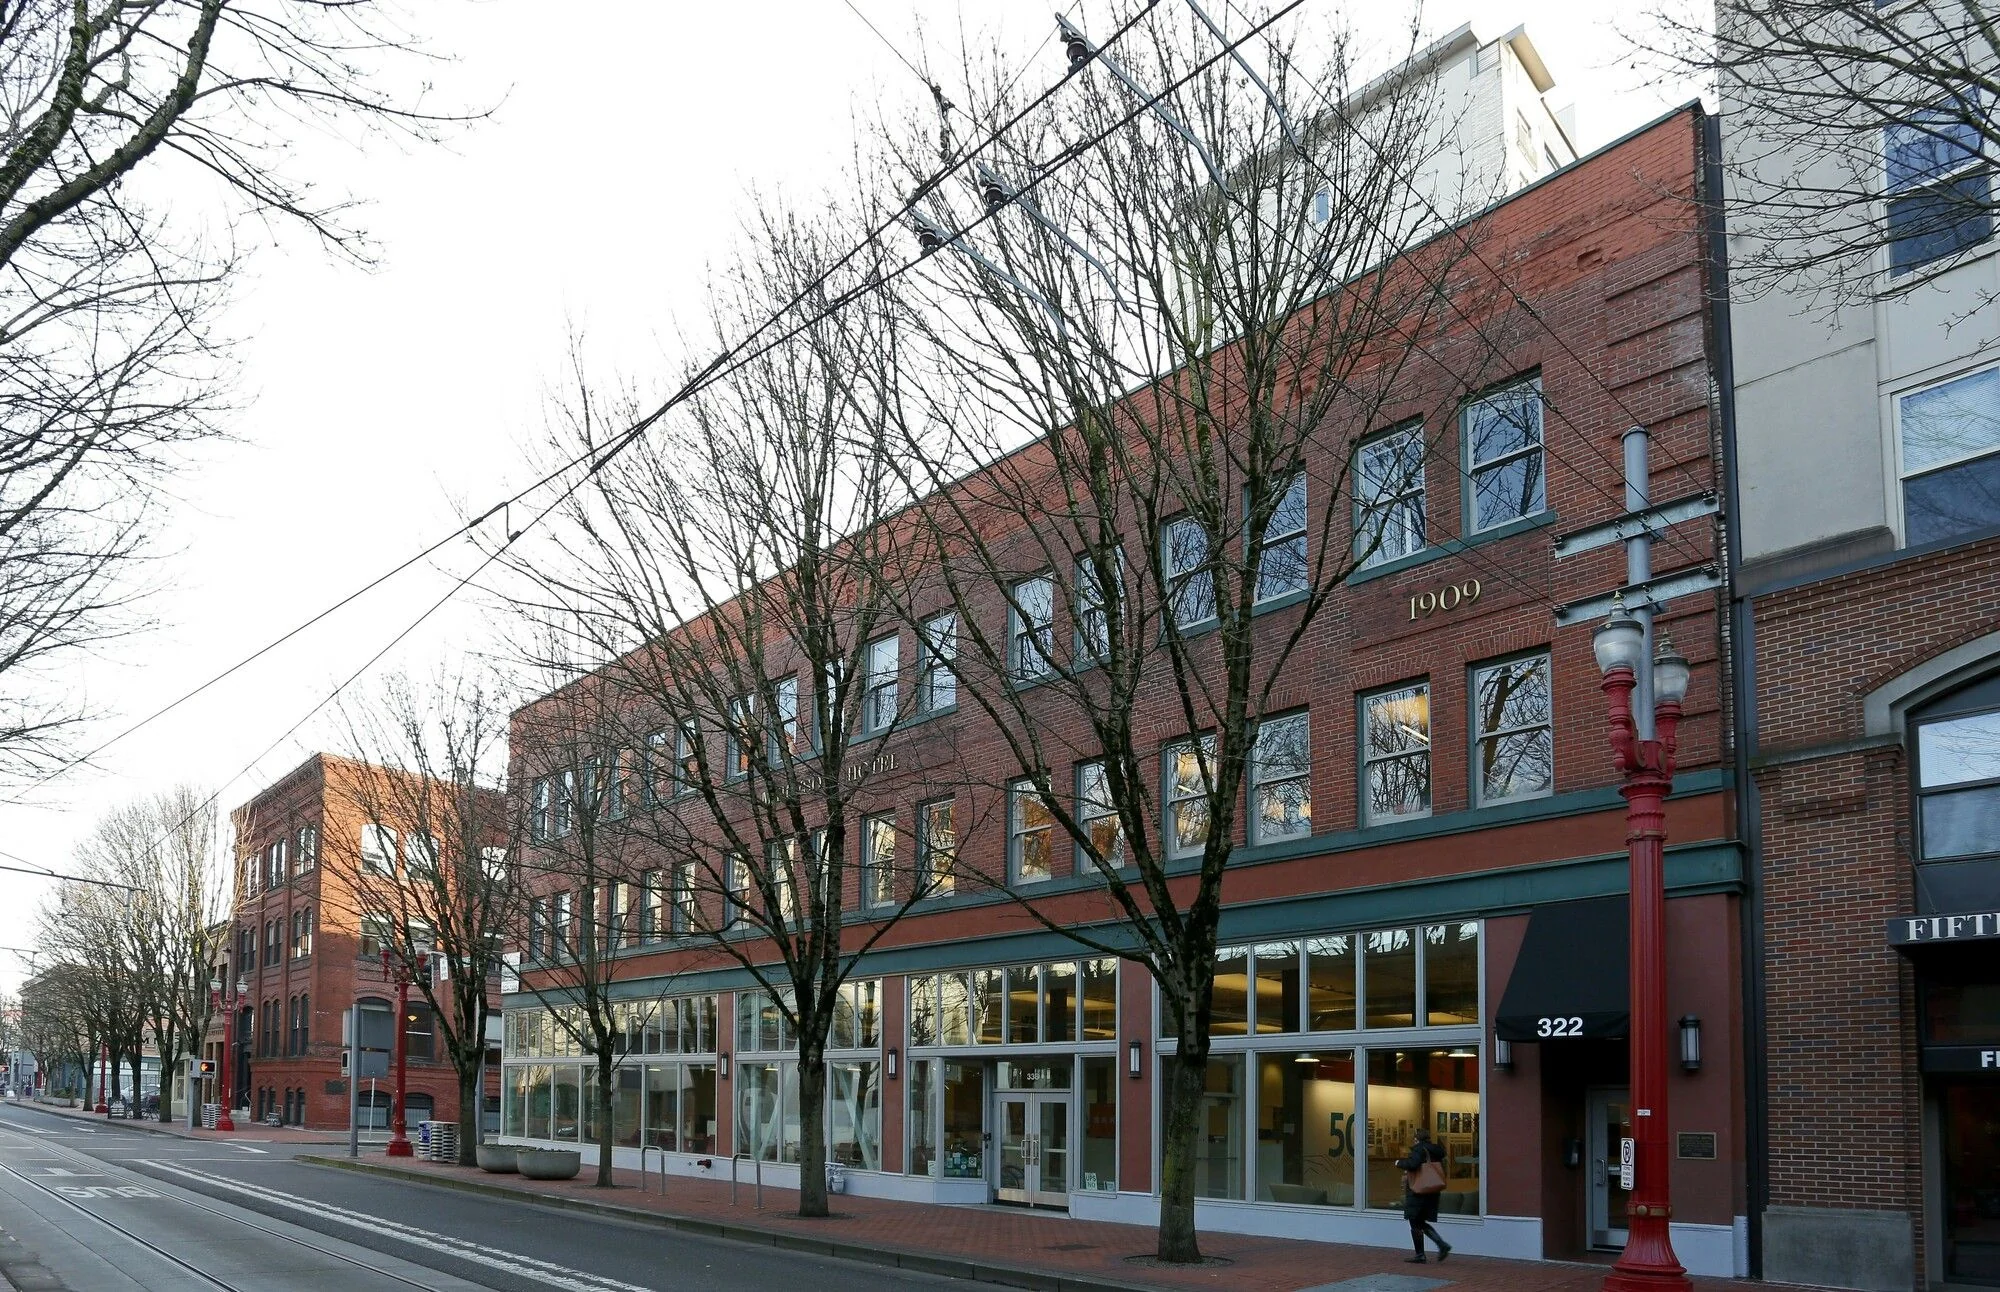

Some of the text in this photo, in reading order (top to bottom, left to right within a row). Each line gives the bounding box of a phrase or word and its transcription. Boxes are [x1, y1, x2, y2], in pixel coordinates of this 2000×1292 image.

[1408, 578, 1480, 620] 1909
[1905, 912, 2000, 942] FIFT
[1537, 1016, 1583, 1037] 322
[56, 1186, 160, 1198] BUS
